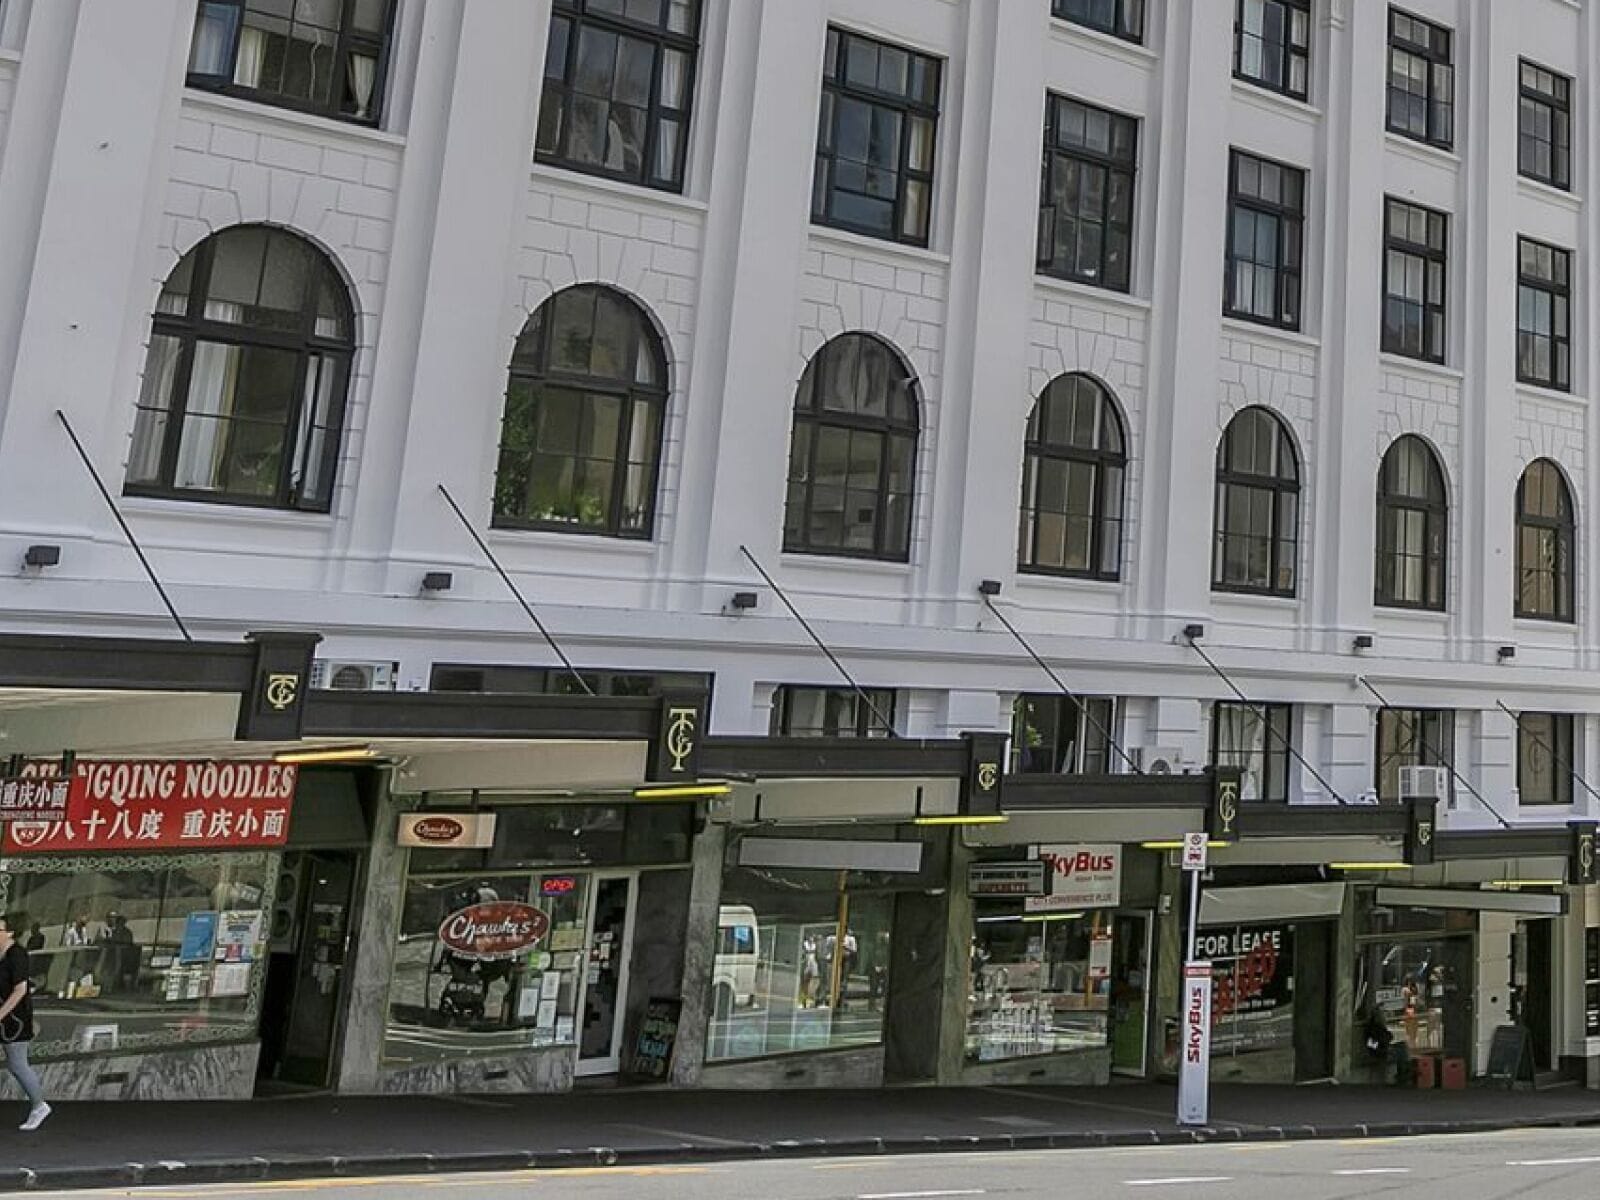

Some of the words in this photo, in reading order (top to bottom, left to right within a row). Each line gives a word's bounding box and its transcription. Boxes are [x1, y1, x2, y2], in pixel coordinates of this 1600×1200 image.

[0, 779, 69, 808] 重庆小面
[182, 762, 297, 799] NOODLES
[180, 806, 287, 839] 重庆小面
[543, 878, 576, 891] OPEN
[1194, 935, 1229, 956] FOR
[1232, 930, 1281, 953] LEASE
[1187, 986, 1204, 1065] SkyBus
